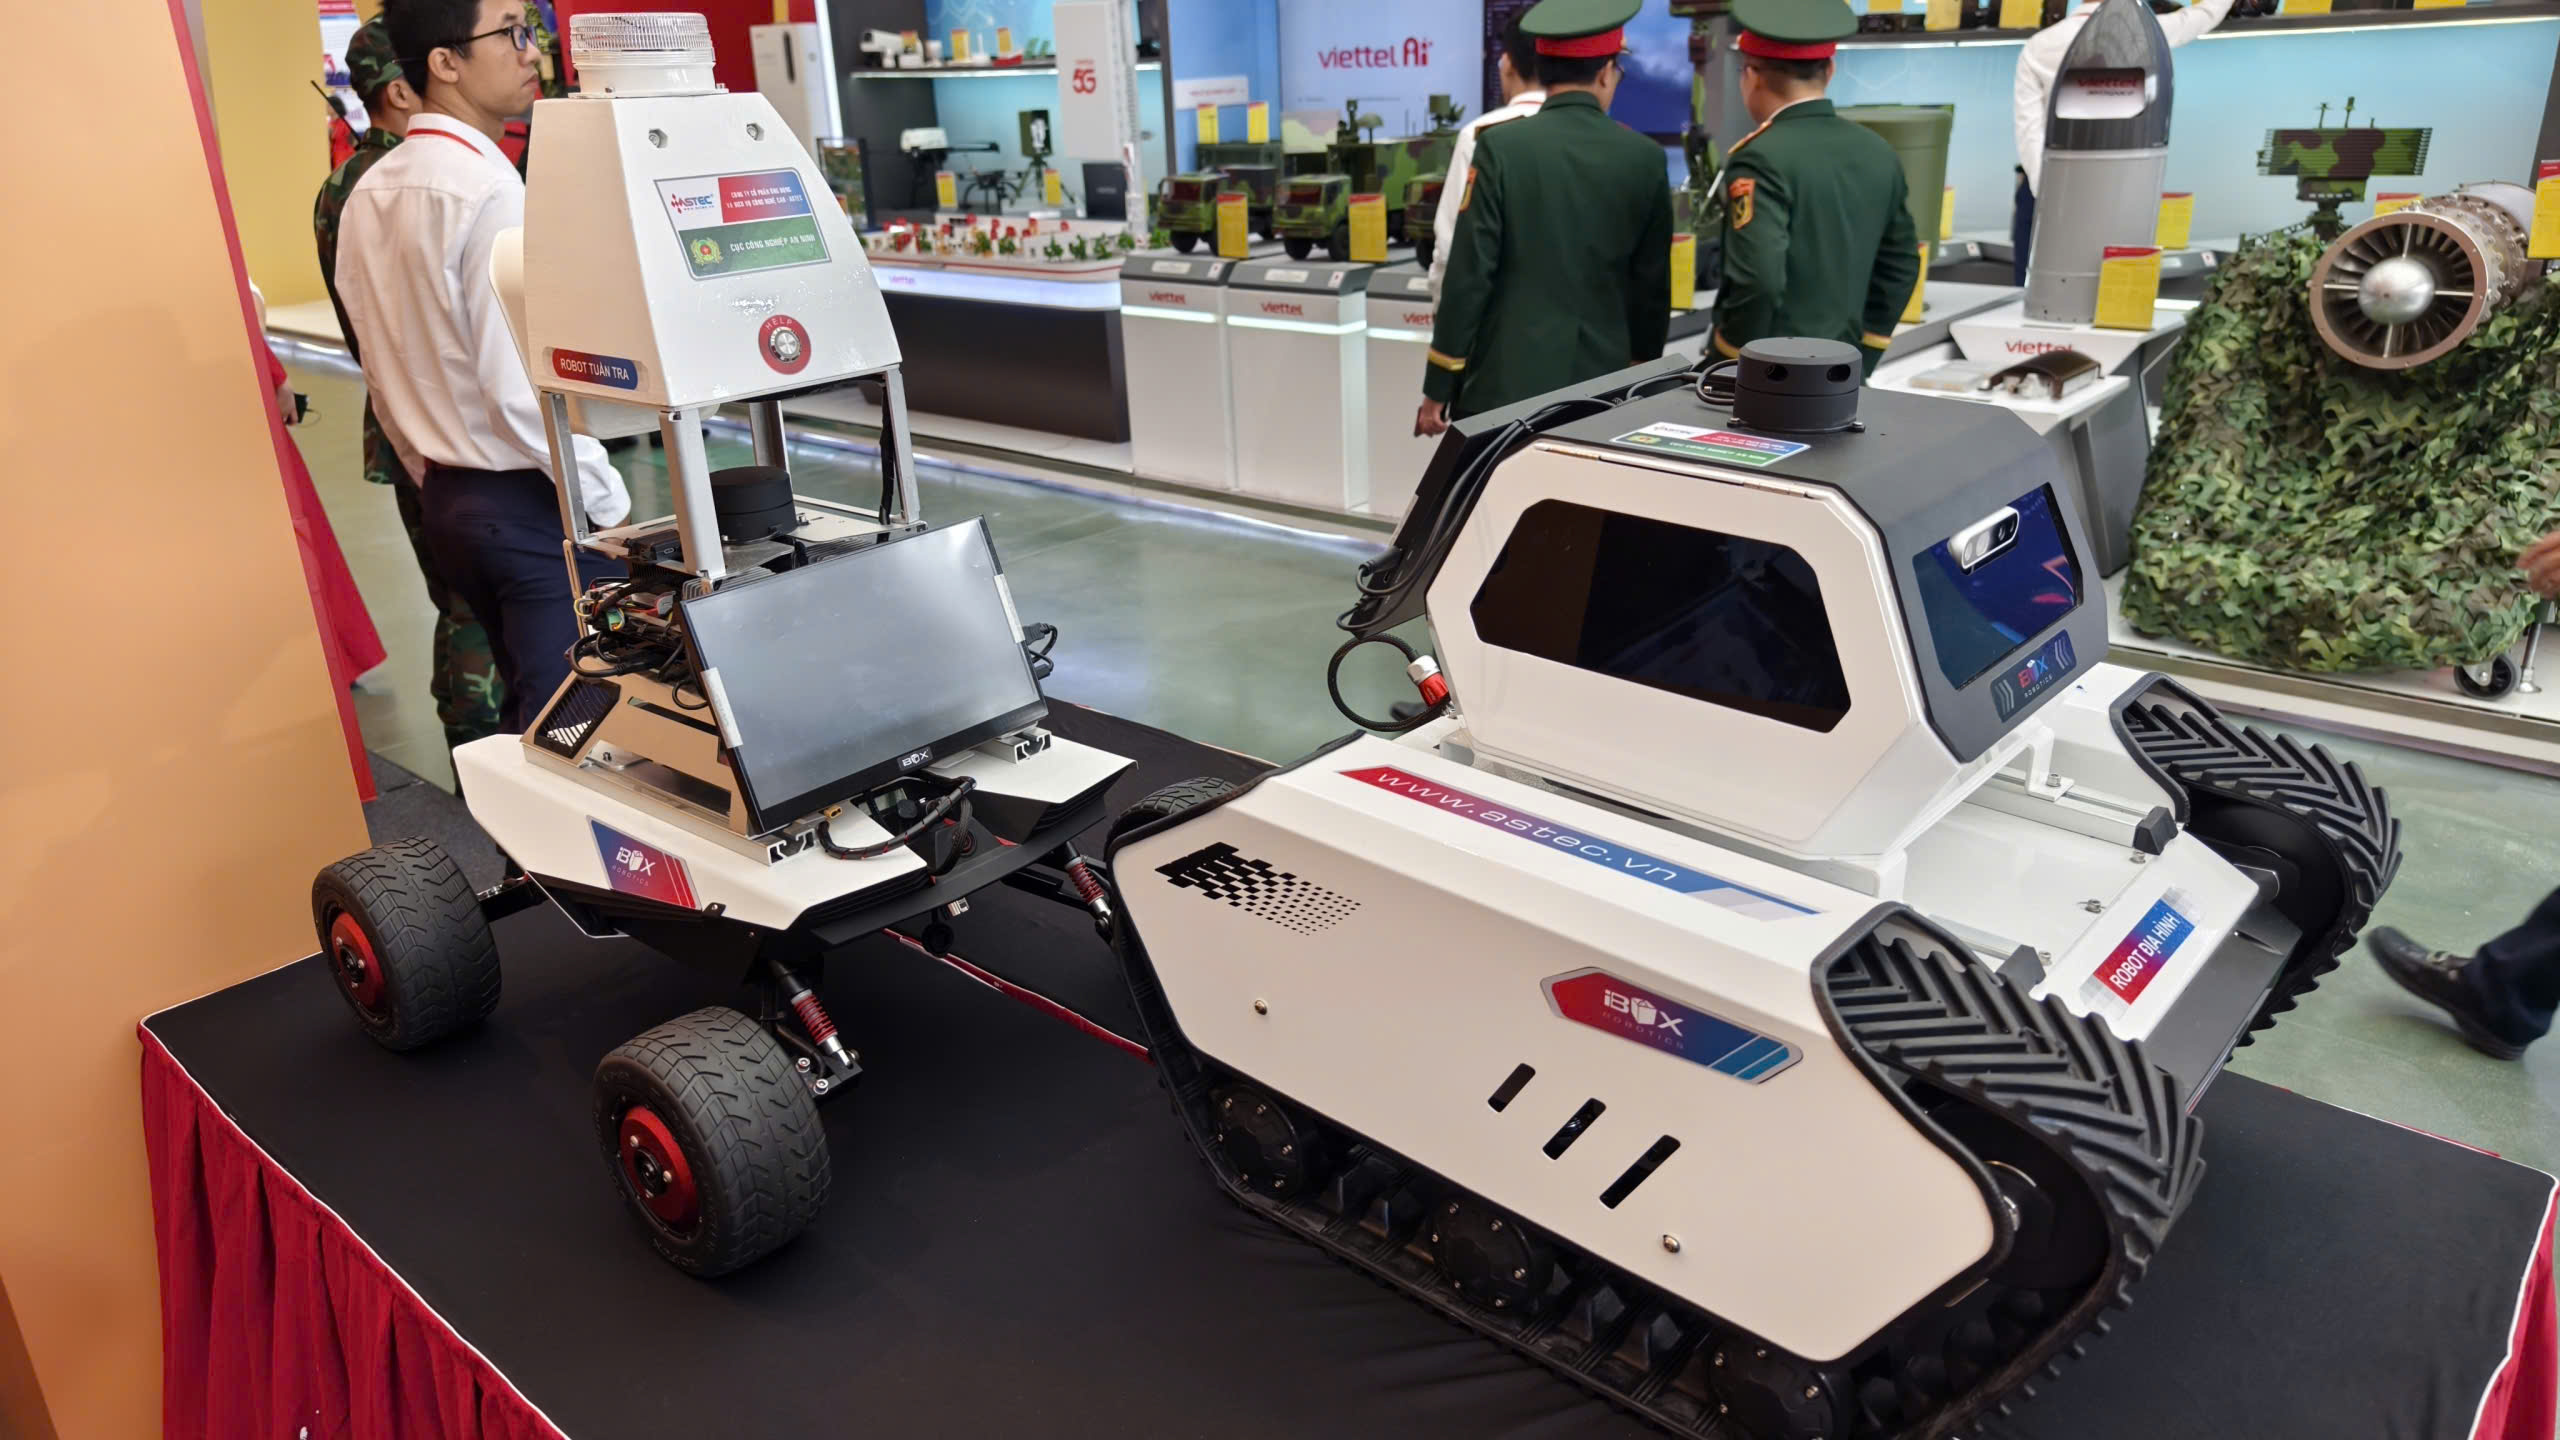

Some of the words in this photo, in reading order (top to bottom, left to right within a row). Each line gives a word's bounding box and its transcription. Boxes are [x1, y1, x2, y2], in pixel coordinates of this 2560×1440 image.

[1318, 45, 1398, 69] viettel
[1073, 68, 1096, 94] 5G
[745, 240, 764, 250] CÔNG
[1149, 291, 1186, 305] viettel
[1261, 302, 1304, 317] viettel
[765, 317, 793, 330] HELP
[560, 358, 588, 373] ROBOT
[611, 366, 630, 380] TRA
[1377, 772, 1678, 882] www.astec.vn
[611, 864, 650, 888] ROBOTICS
[2109, 949, 2148, 991] ROBOT
[1601, 1011, 1685, 1051] ROBOTICS
